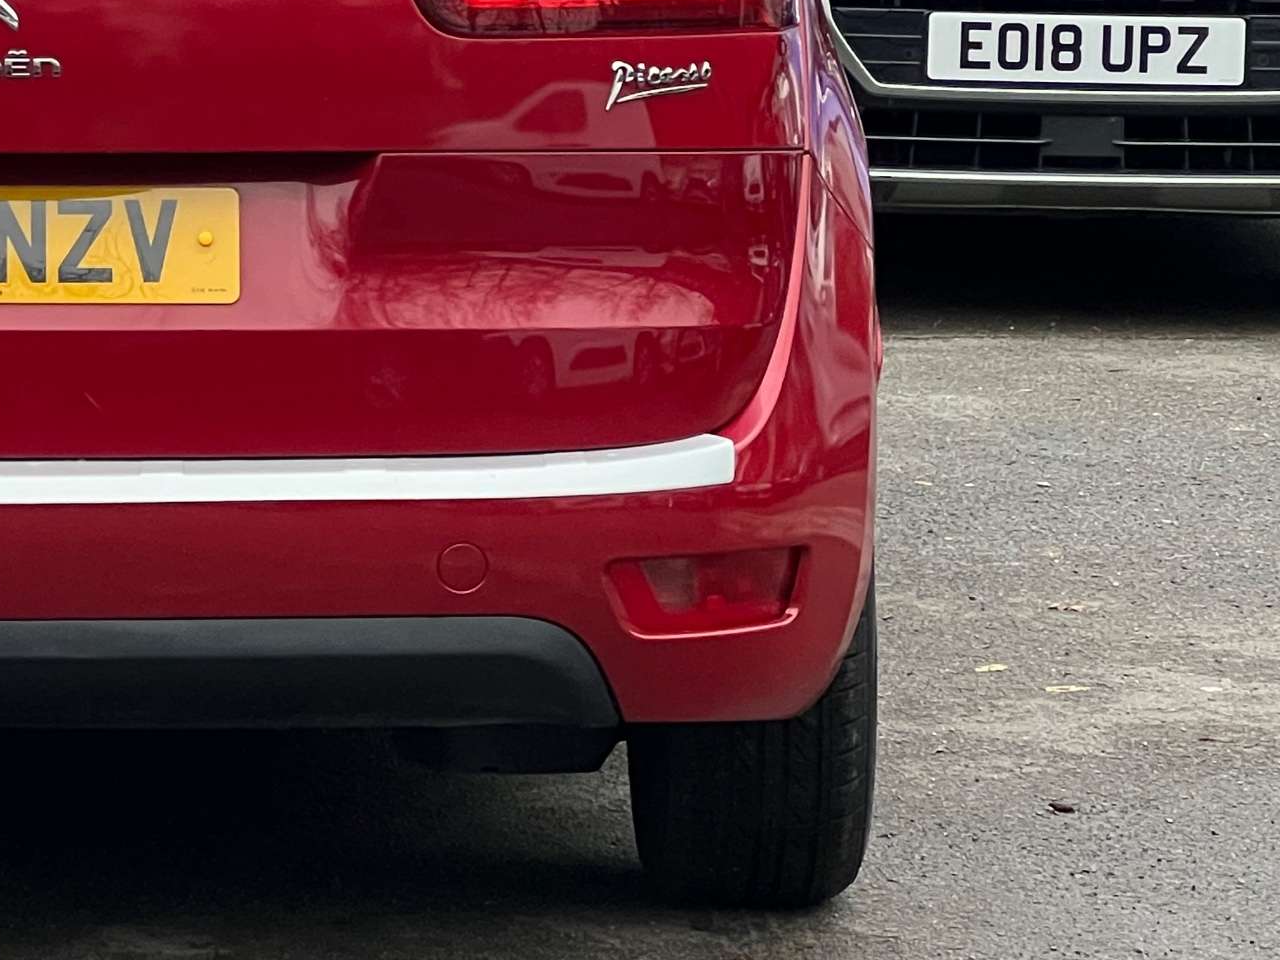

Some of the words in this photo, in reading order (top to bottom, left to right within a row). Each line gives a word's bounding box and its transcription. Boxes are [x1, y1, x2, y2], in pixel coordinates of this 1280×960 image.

[959, 21, 1082, 71] EO18
[1101, 24, 1210, 75] UPZ
[605, 60, 712, 111] Picasso
